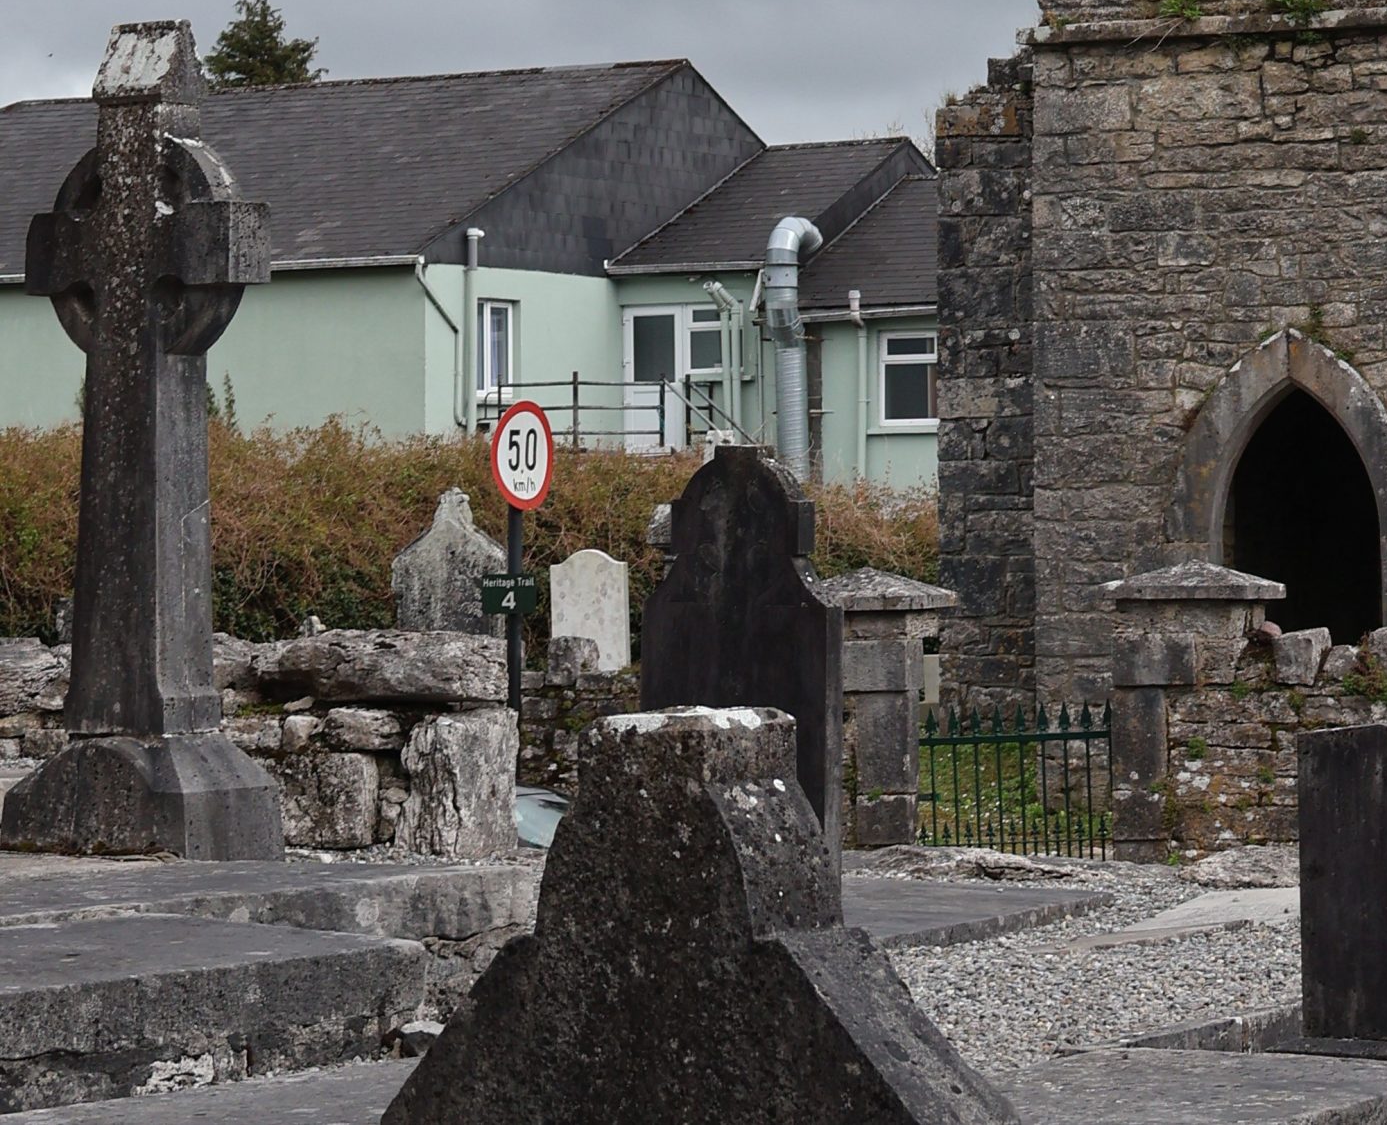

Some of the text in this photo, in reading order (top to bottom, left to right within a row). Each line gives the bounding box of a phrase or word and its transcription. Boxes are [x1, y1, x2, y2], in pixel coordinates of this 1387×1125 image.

[508, 428, 538, 471] 50
[513, 477, 536, 492] km/h
[483, 576, 535, 588] Heritage Trail
[501, 591, 516, 609] 4
